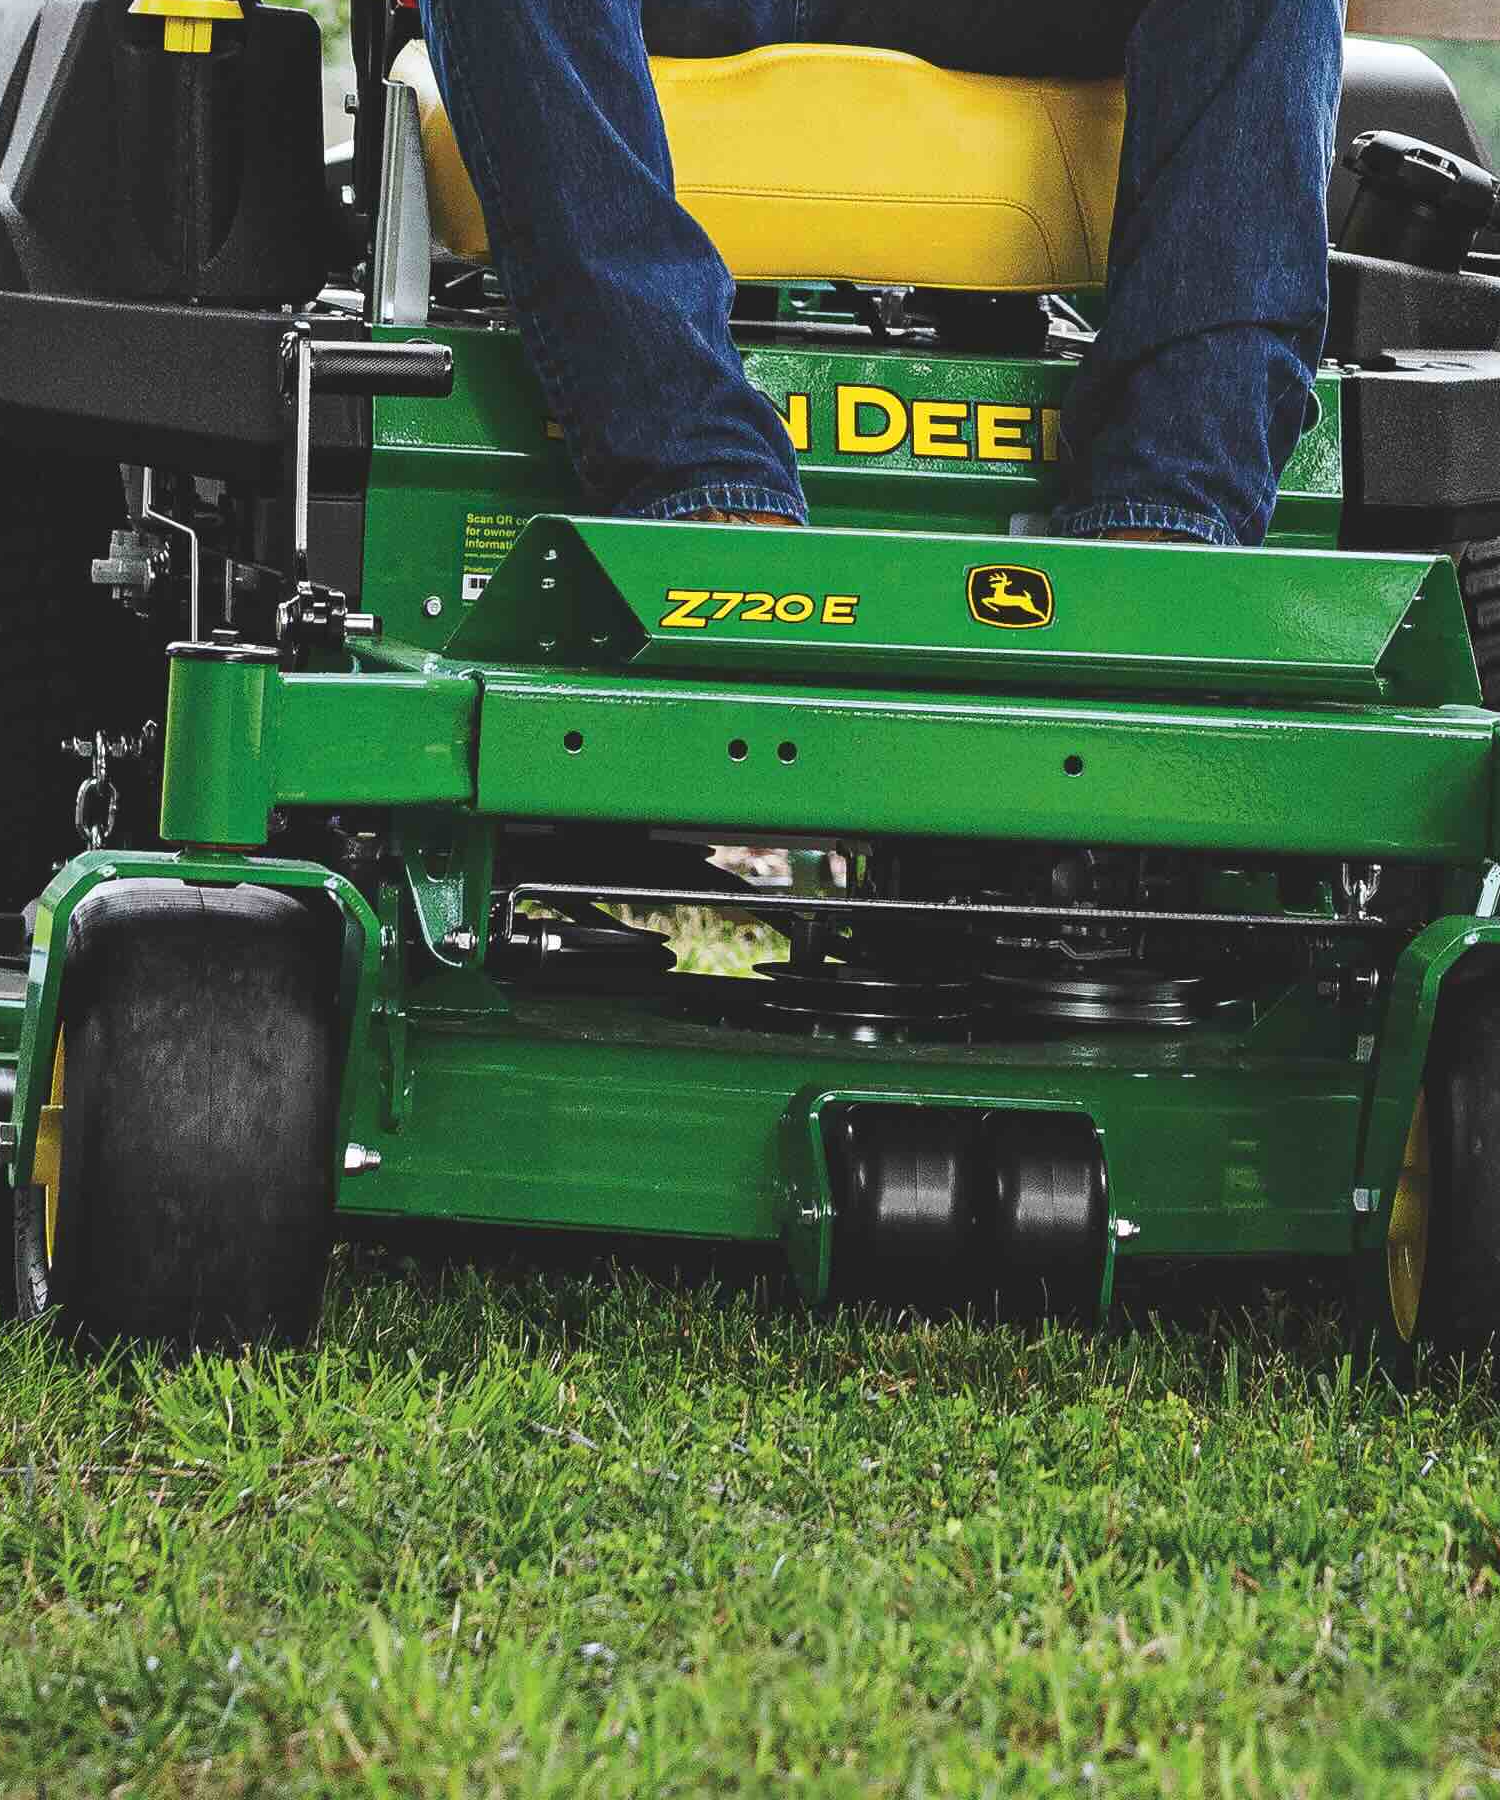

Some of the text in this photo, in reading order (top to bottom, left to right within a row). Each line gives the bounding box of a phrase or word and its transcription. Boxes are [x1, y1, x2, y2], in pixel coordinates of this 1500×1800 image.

[467, 513, 494, 524] Scan
[496, 515, 513, 525] QR
[466, 526, 480, 537] for
